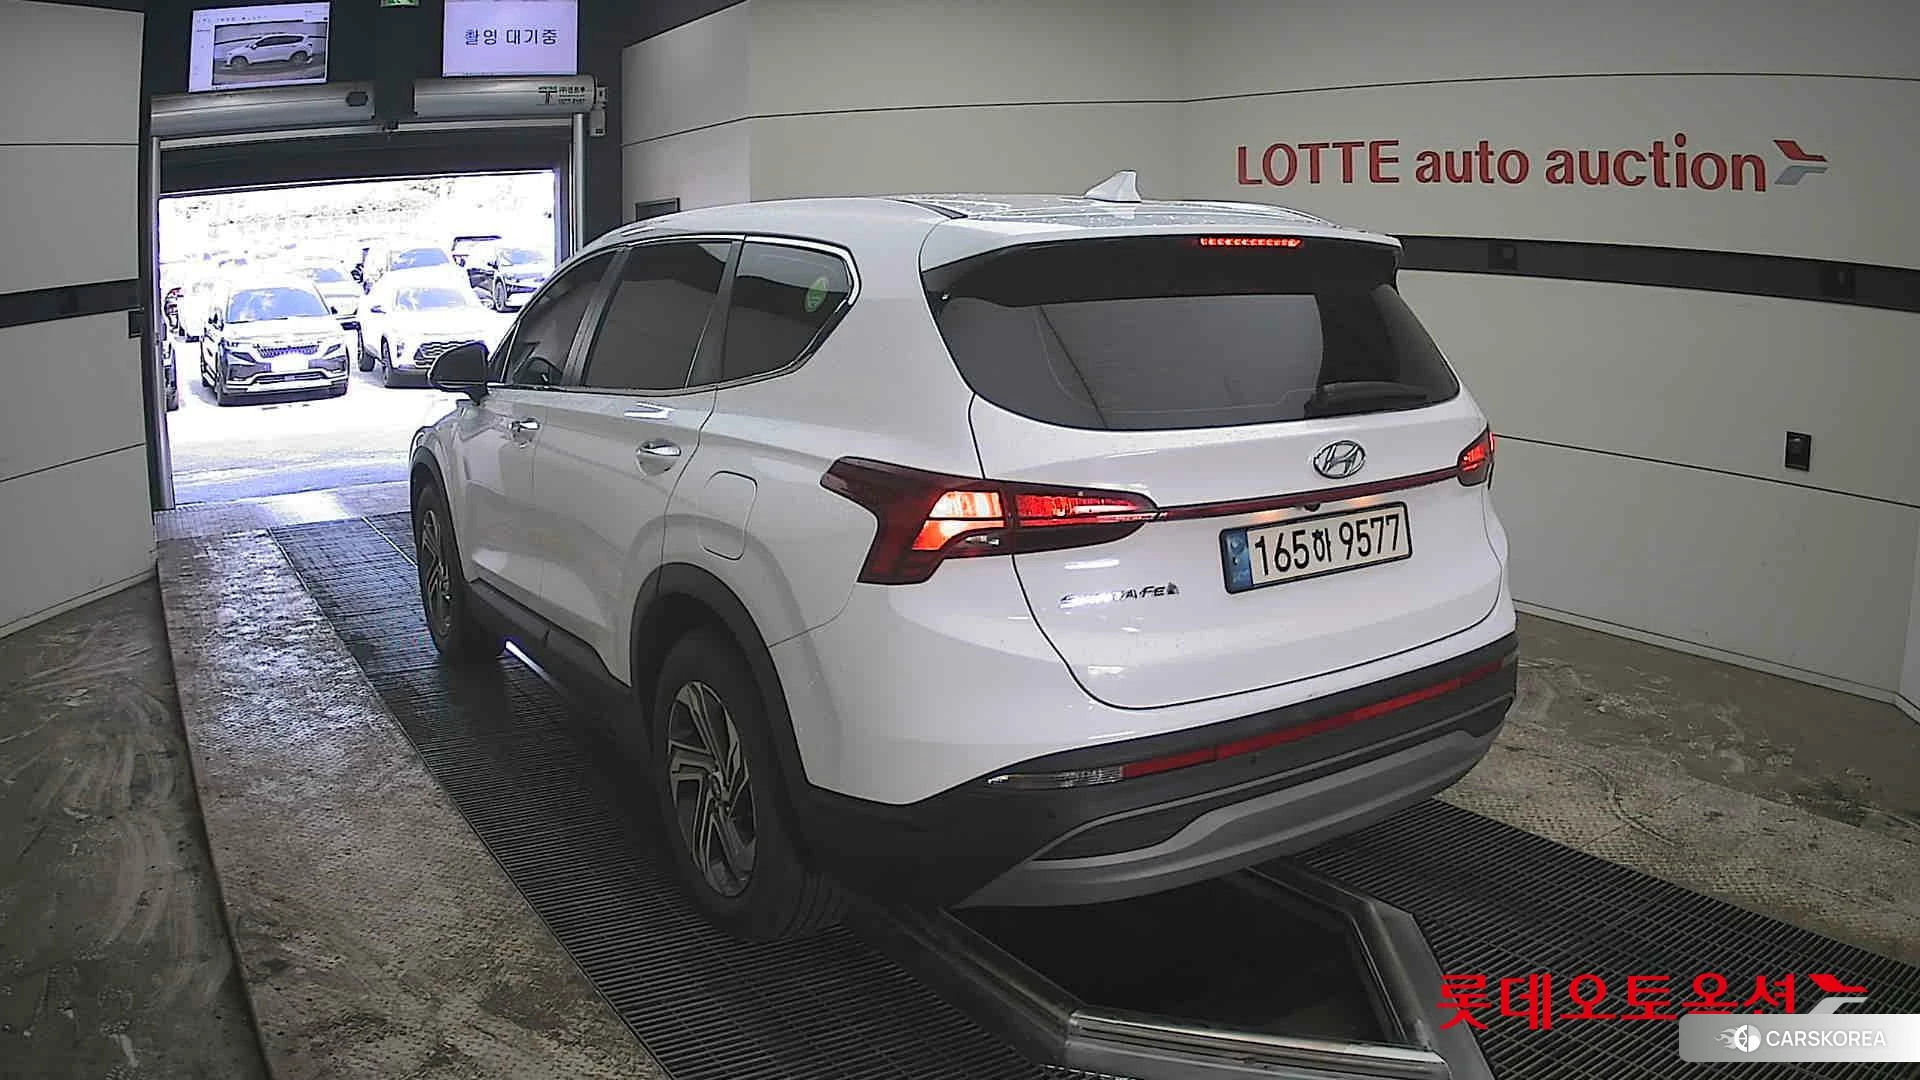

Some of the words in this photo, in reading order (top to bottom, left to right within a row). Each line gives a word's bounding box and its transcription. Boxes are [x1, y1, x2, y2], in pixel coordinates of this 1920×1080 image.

[505, 28, 558, 46] 대기중
[1238, 140, 1399, 186] LOTTE
[1415, 140, 1530, 185] auto
[1545, 133, 1766, 192] auction
[1255, 528, 1332, 576] 165하
[1338, 513, 1399, 560] 9577
